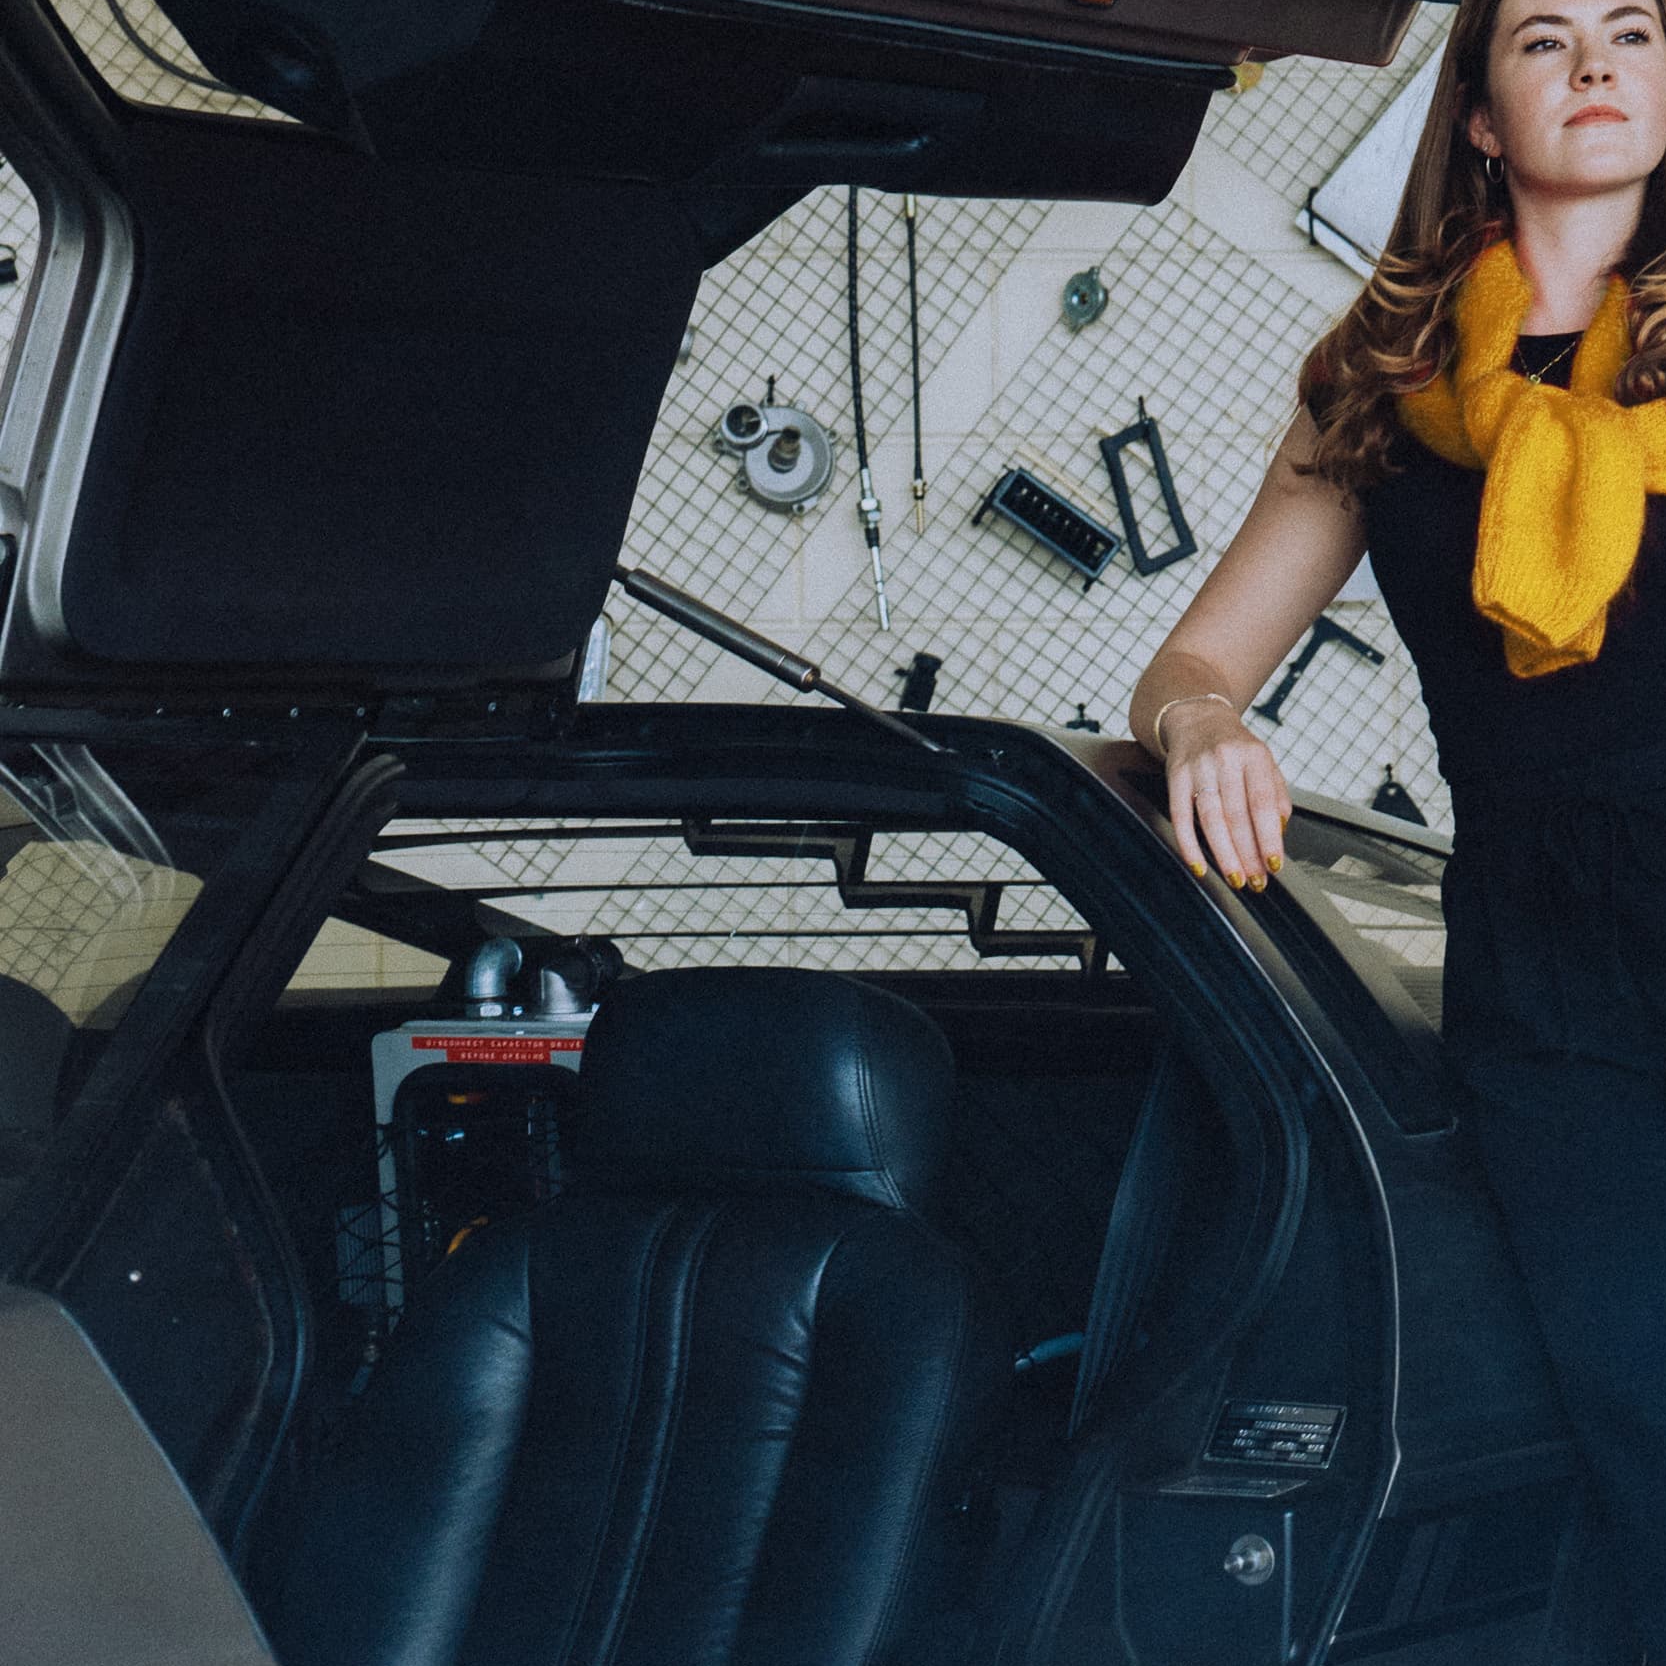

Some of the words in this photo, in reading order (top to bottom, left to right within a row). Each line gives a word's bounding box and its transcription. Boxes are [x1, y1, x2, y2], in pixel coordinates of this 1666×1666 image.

[425, 1039, 485, 1048] DISCONNECT
[490, 1039, 545, 1049] CAPACITOR
[550, 1040, 582, 1050] DRIVE
[460, 1052, 496, 1060] BEFORE
[502, 1052, 545, 1061] OPENING
